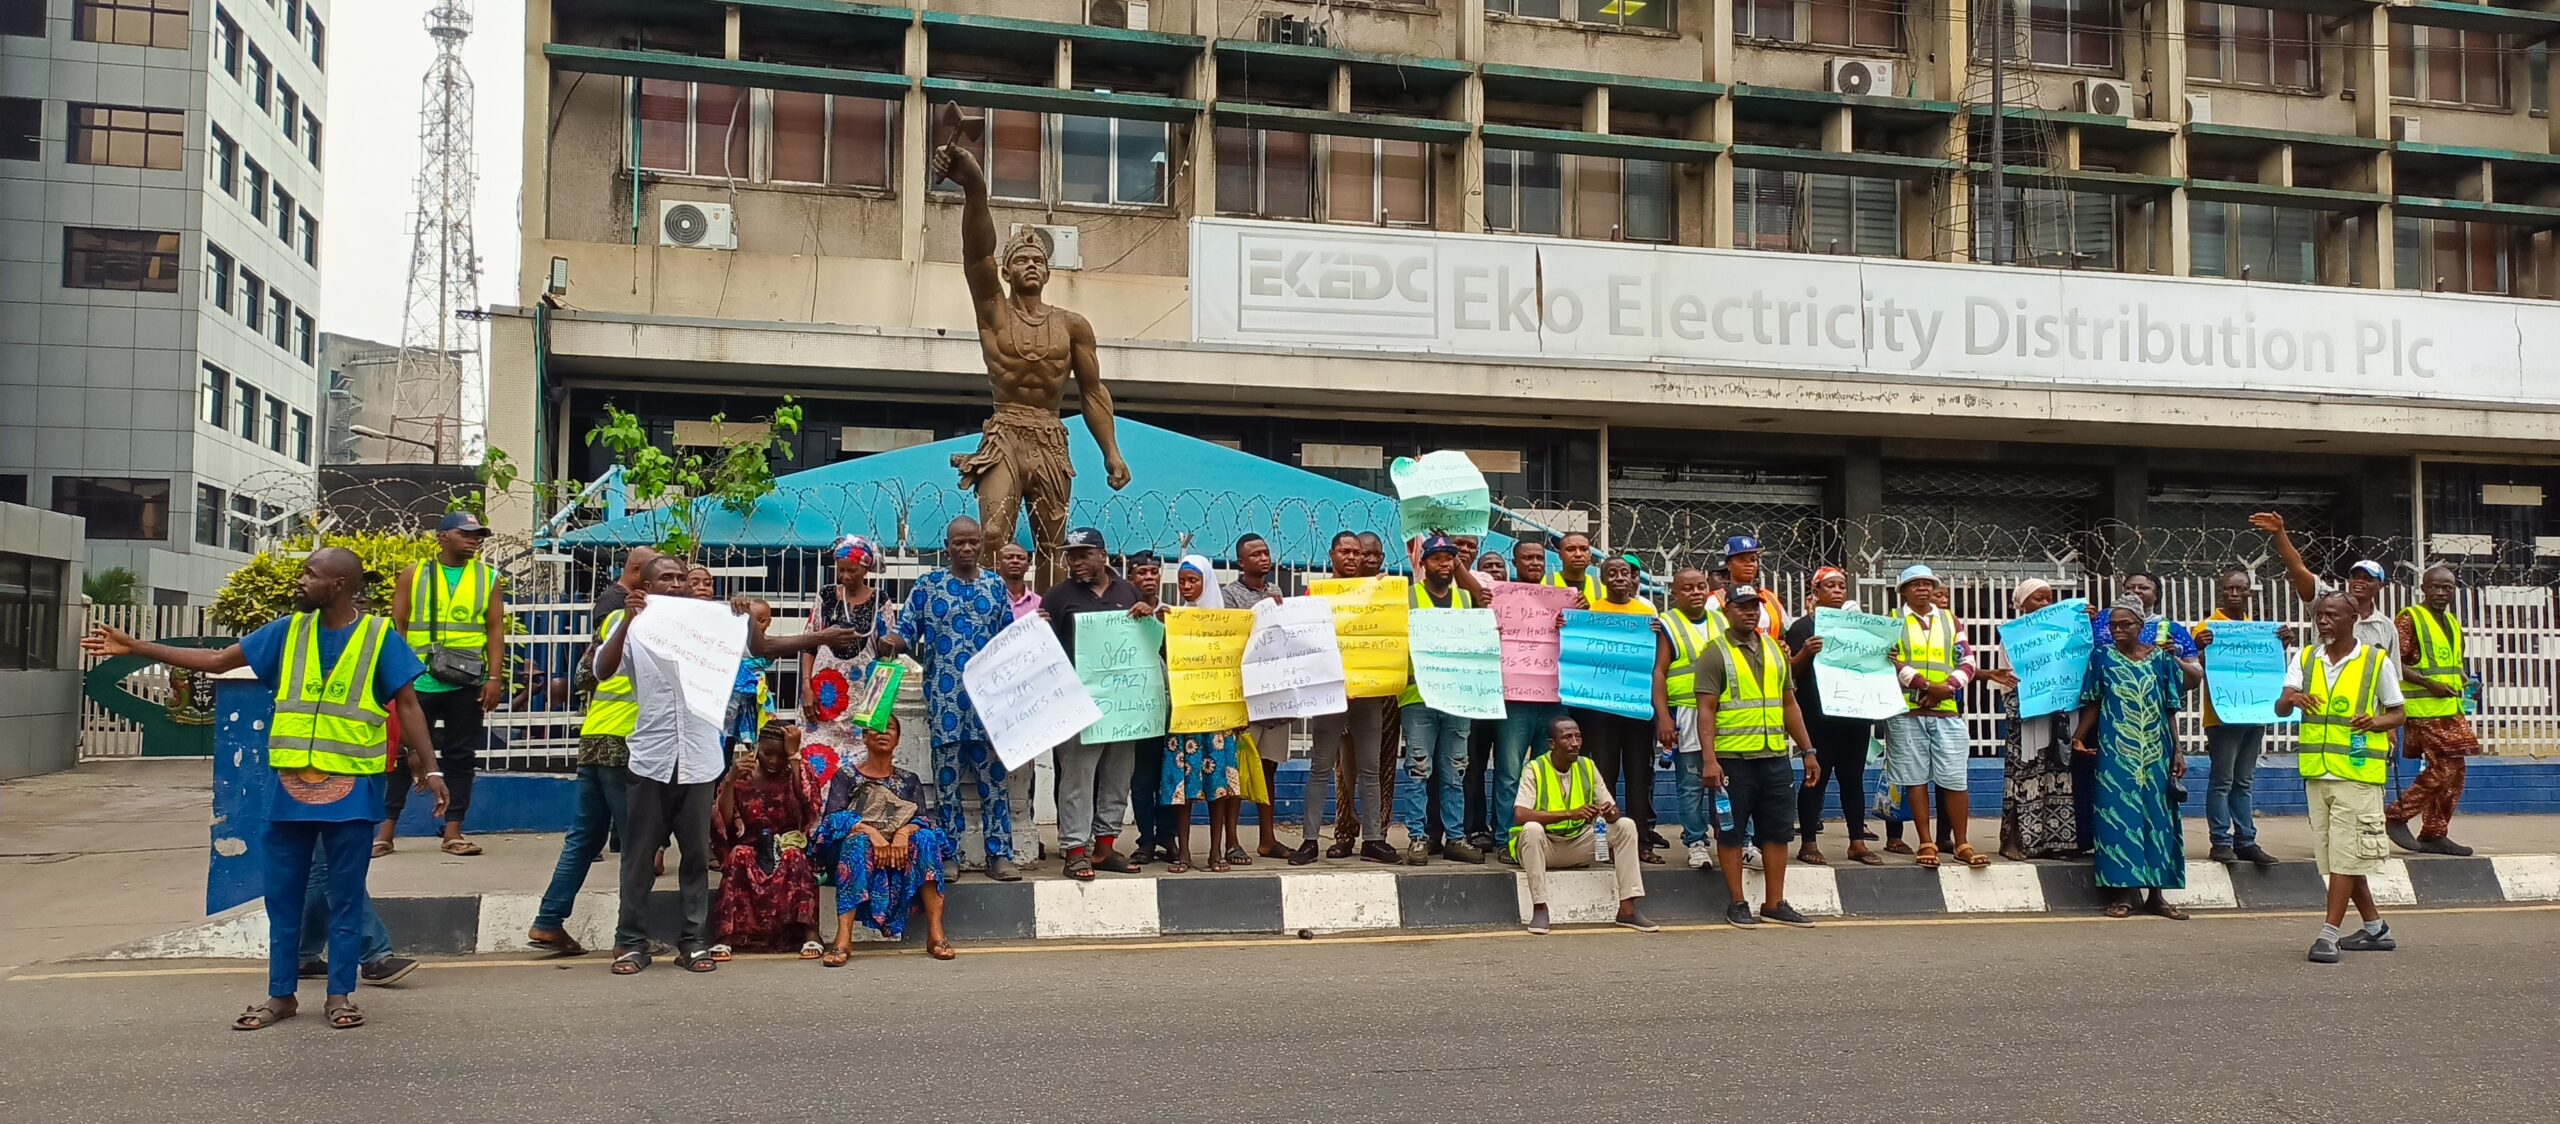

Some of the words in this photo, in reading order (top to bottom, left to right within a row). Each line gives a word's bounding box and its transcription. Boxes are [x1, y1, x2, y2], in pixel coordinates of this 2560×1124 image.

[1250, 248, 1428, 303] EKEDC
[1454, 266, 1584, 335] Eko
[1608, 274, 1944, 369] Electricity
[1965, 296, 2335, 372] Distribution
[2355, 318, 2435, 379] Plc
[1426, 495, 1468, 509] CABLES
[1101, 639, 1137, 670] STOP
[1586, 638, 1640, 656] PROTECT
[2218, 640, 2275, 656] DARKNESS
[1591, 657, 1628, 685] YOUR
[2234, 660, 2254, 678] IS
[1005, 680, 1035, 707] OUR
[1100, 671, 1147, 694] CRAZY
[1571, 682, 1644, 705] VALUABLES
[2215, 686, 2270, 708] EVIL
[1005, 695, 1049, 731] LIGHTS
